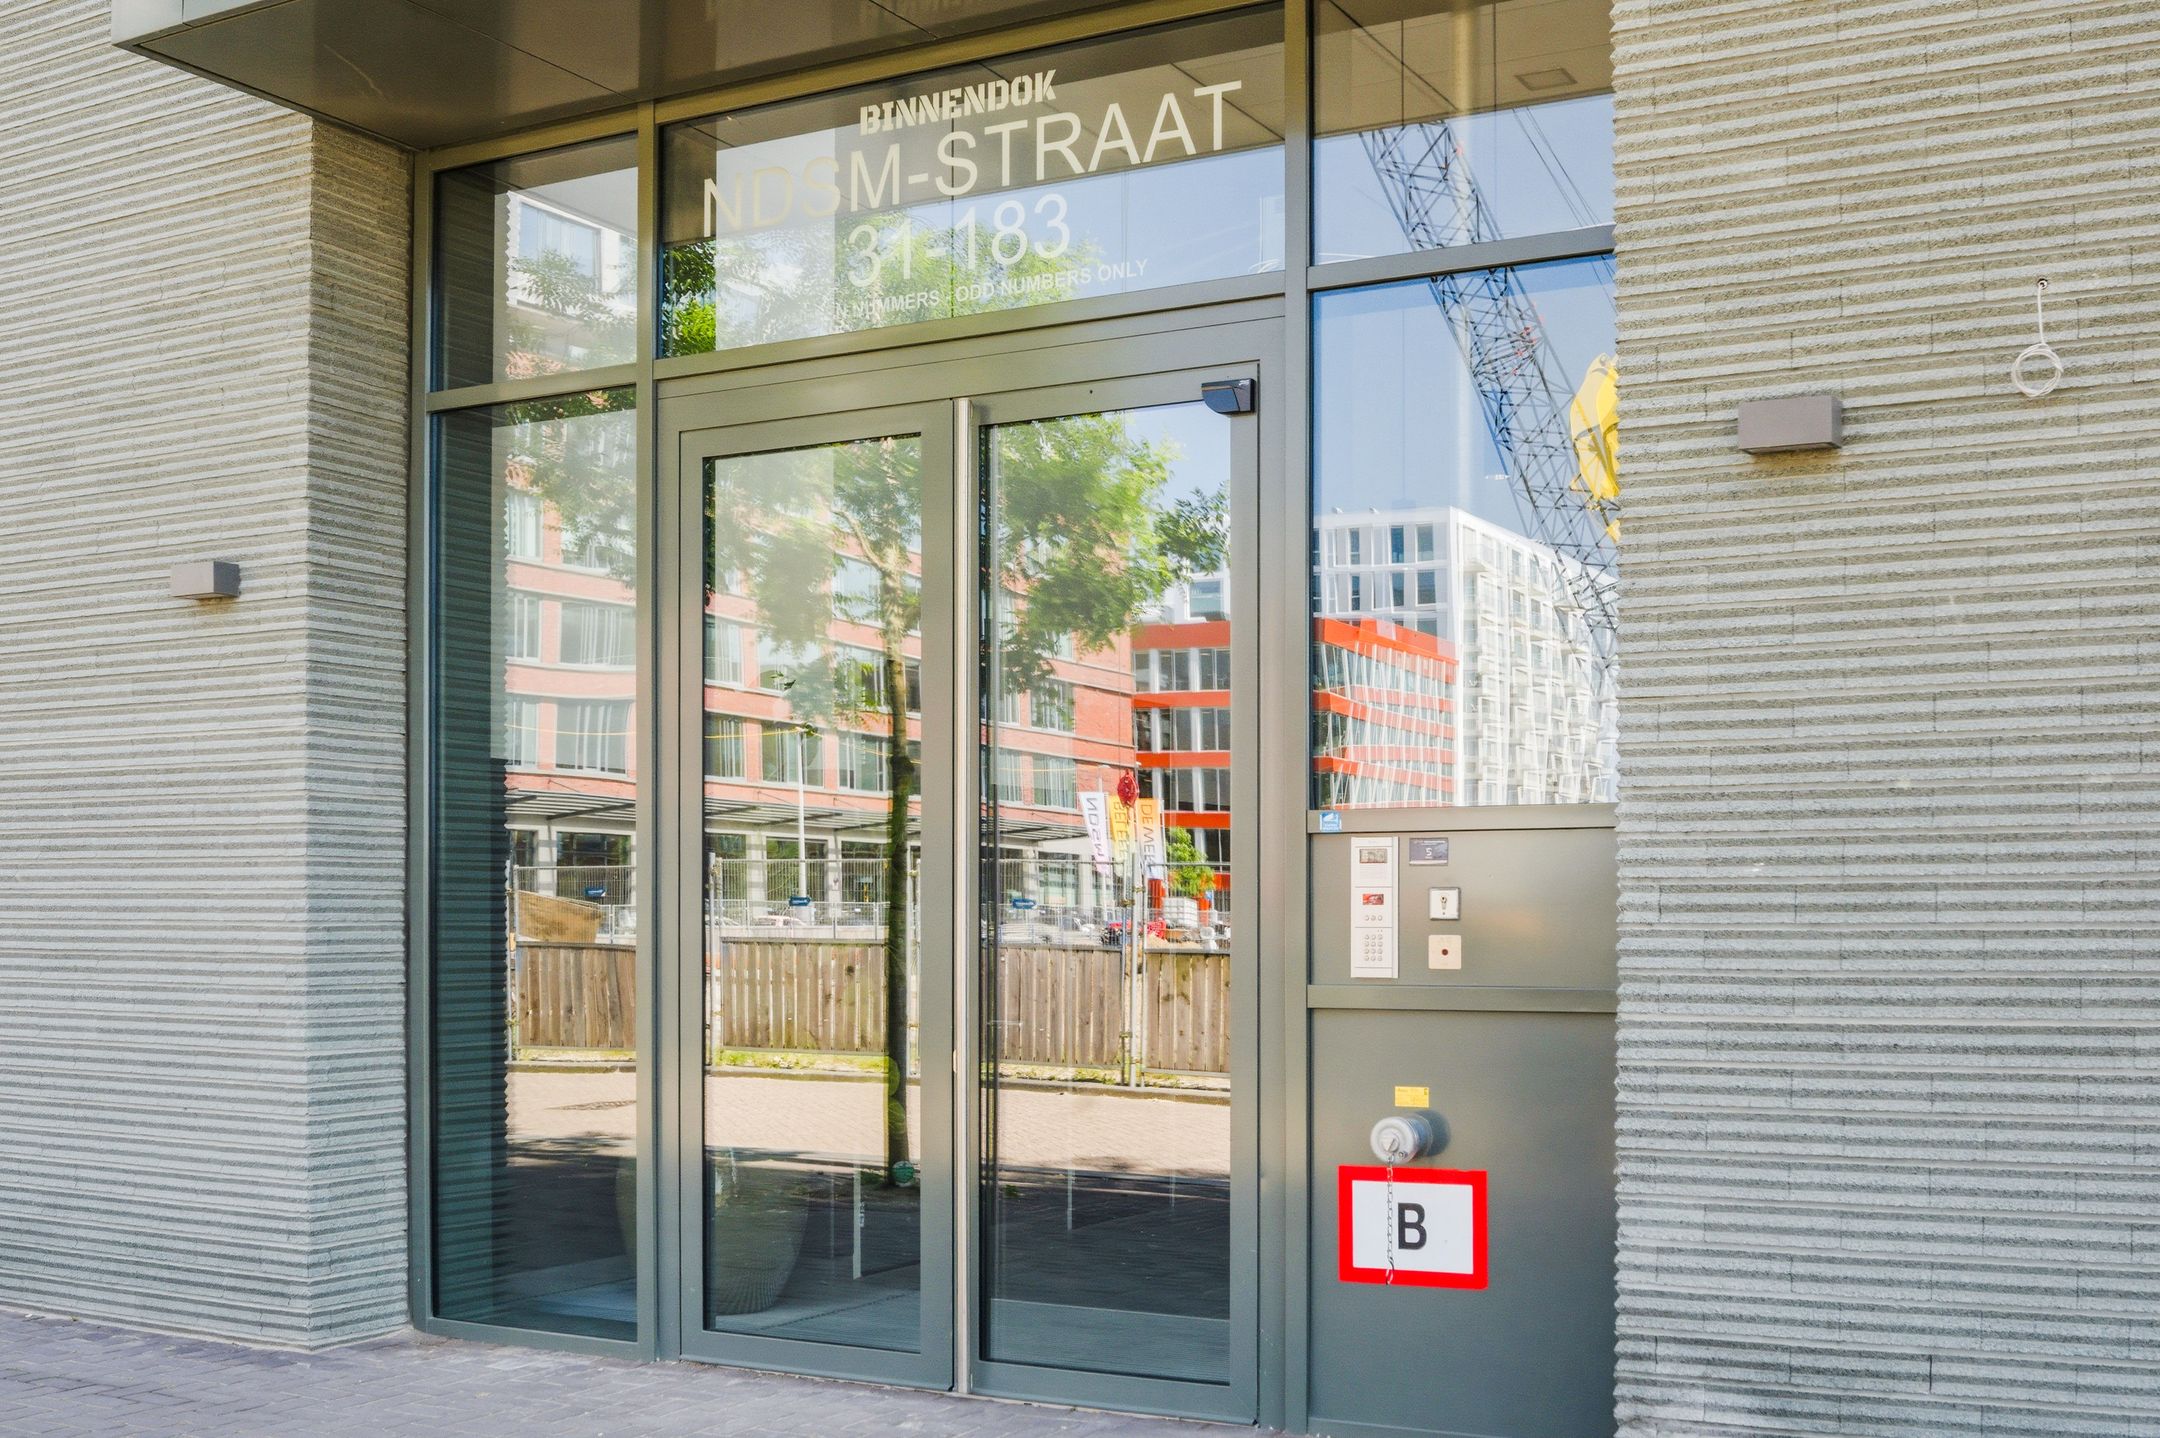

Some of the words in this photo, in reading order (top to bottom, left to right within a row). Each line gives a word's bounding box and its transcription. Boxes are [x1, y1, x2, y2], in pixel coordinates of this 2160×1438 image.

[860, 69, 1057, 137] BINNENDOK
[702, 80, 1243, 238] NDSM-STRAAT
[847, 193, 1070, 289] 31-183
[853, 289, 940, 319] NUMMERS
[956, 281, 995, 304] ODD
[1002, 269, 1092, 297] NUMBERS
[1098, 258, 1148, 283] ONLY
[1398, 1202, 1428, 1250] B
